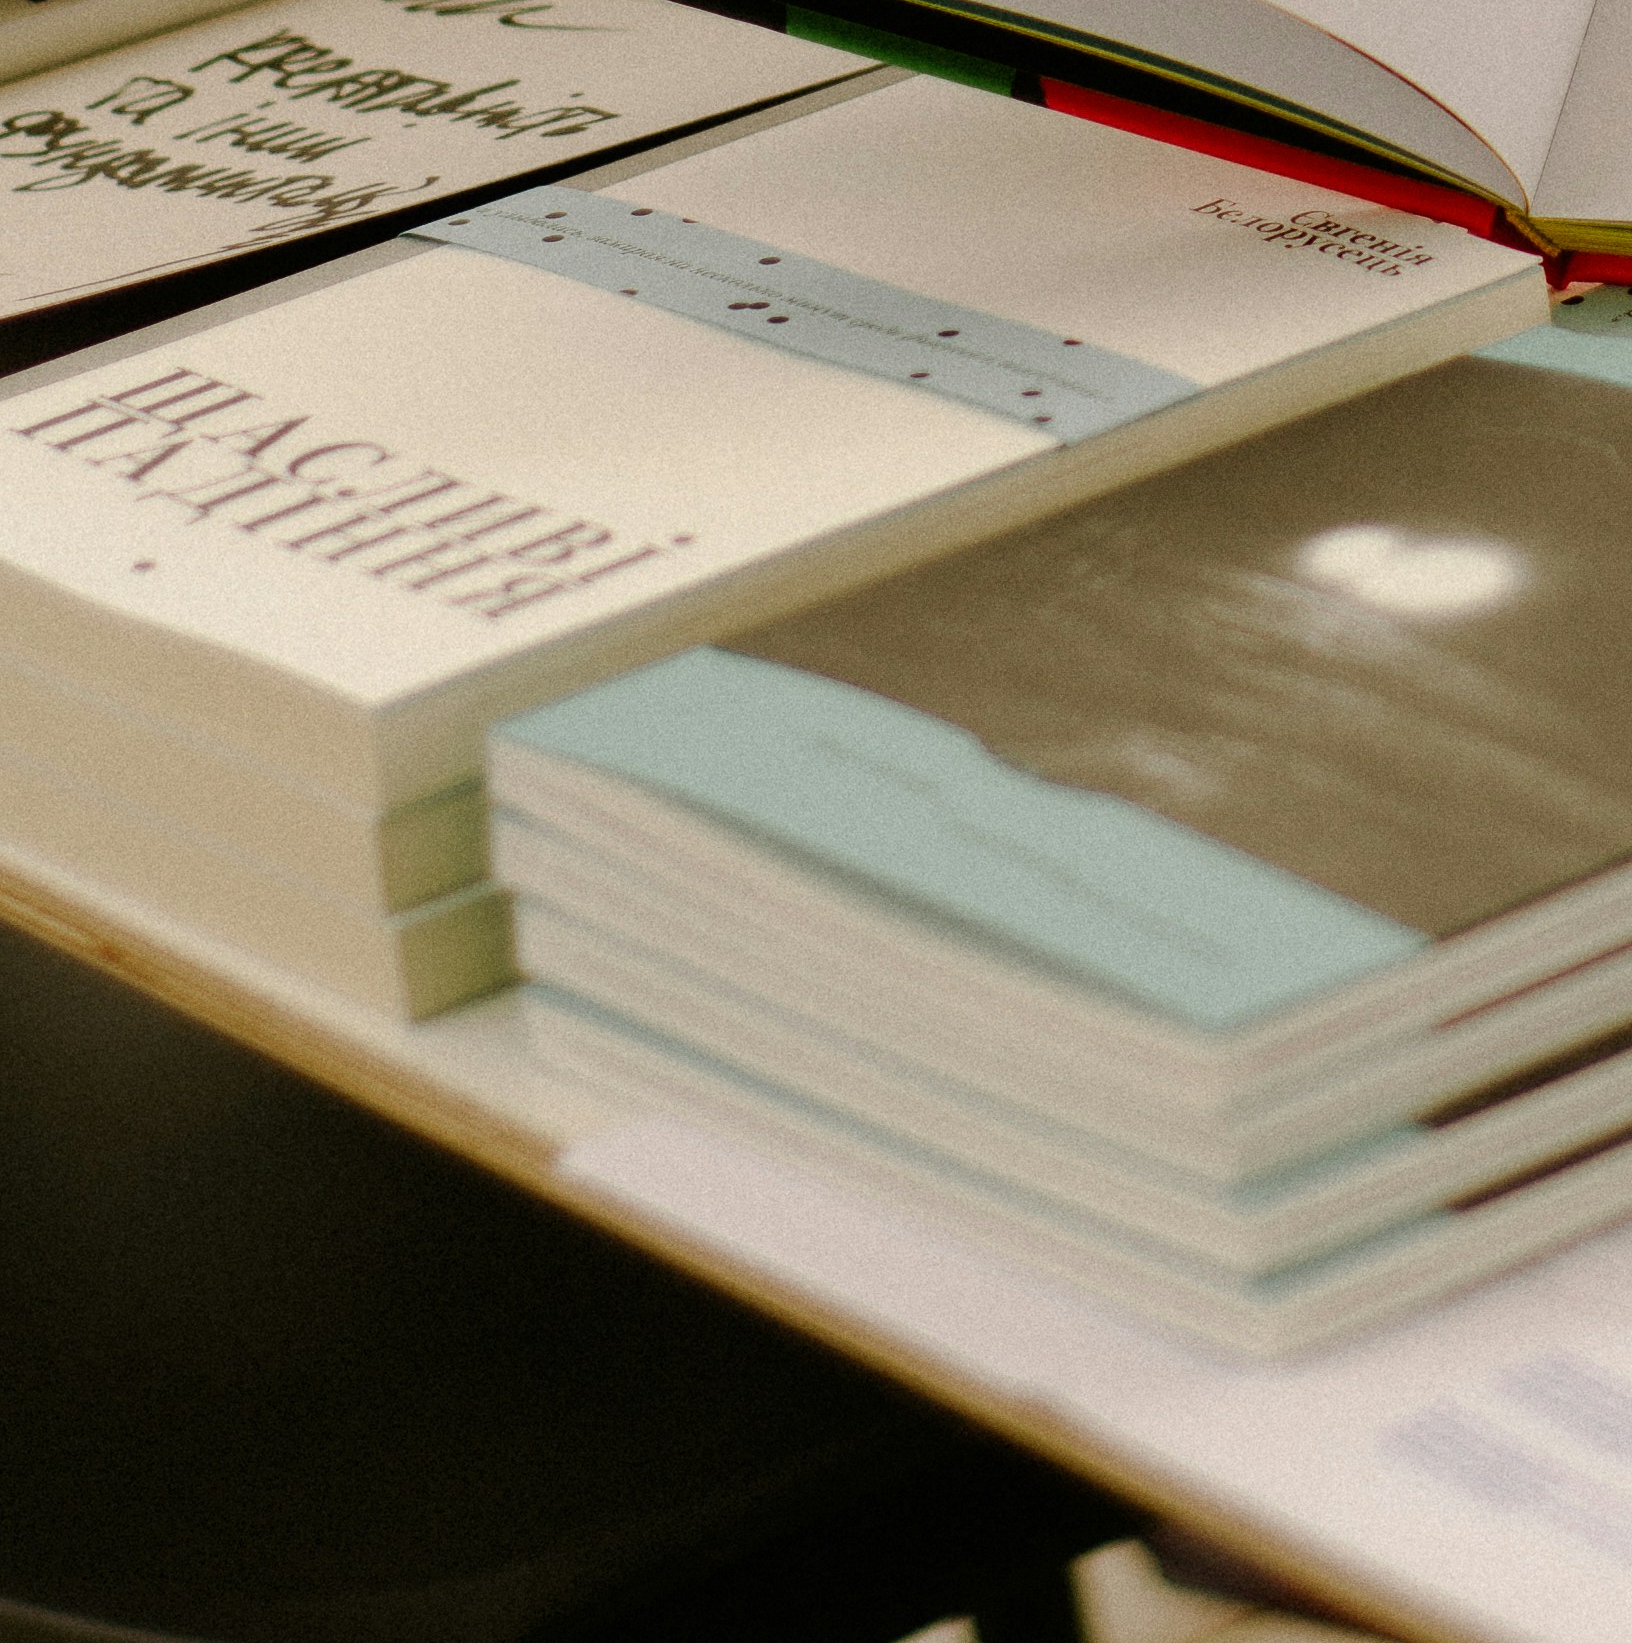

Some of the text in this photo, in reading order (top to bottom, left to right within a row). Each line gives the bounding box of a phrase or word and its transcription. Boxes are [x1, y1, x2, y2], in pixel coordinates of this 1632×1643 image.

[1189, 196, 1404, 278] Белорусець
[1290, 208, 1436, 268] Євгенія
[10, 395, 582, 621] ПАДІННЯ
[93, 365, 697, 586] ЩАСЛИВІ
